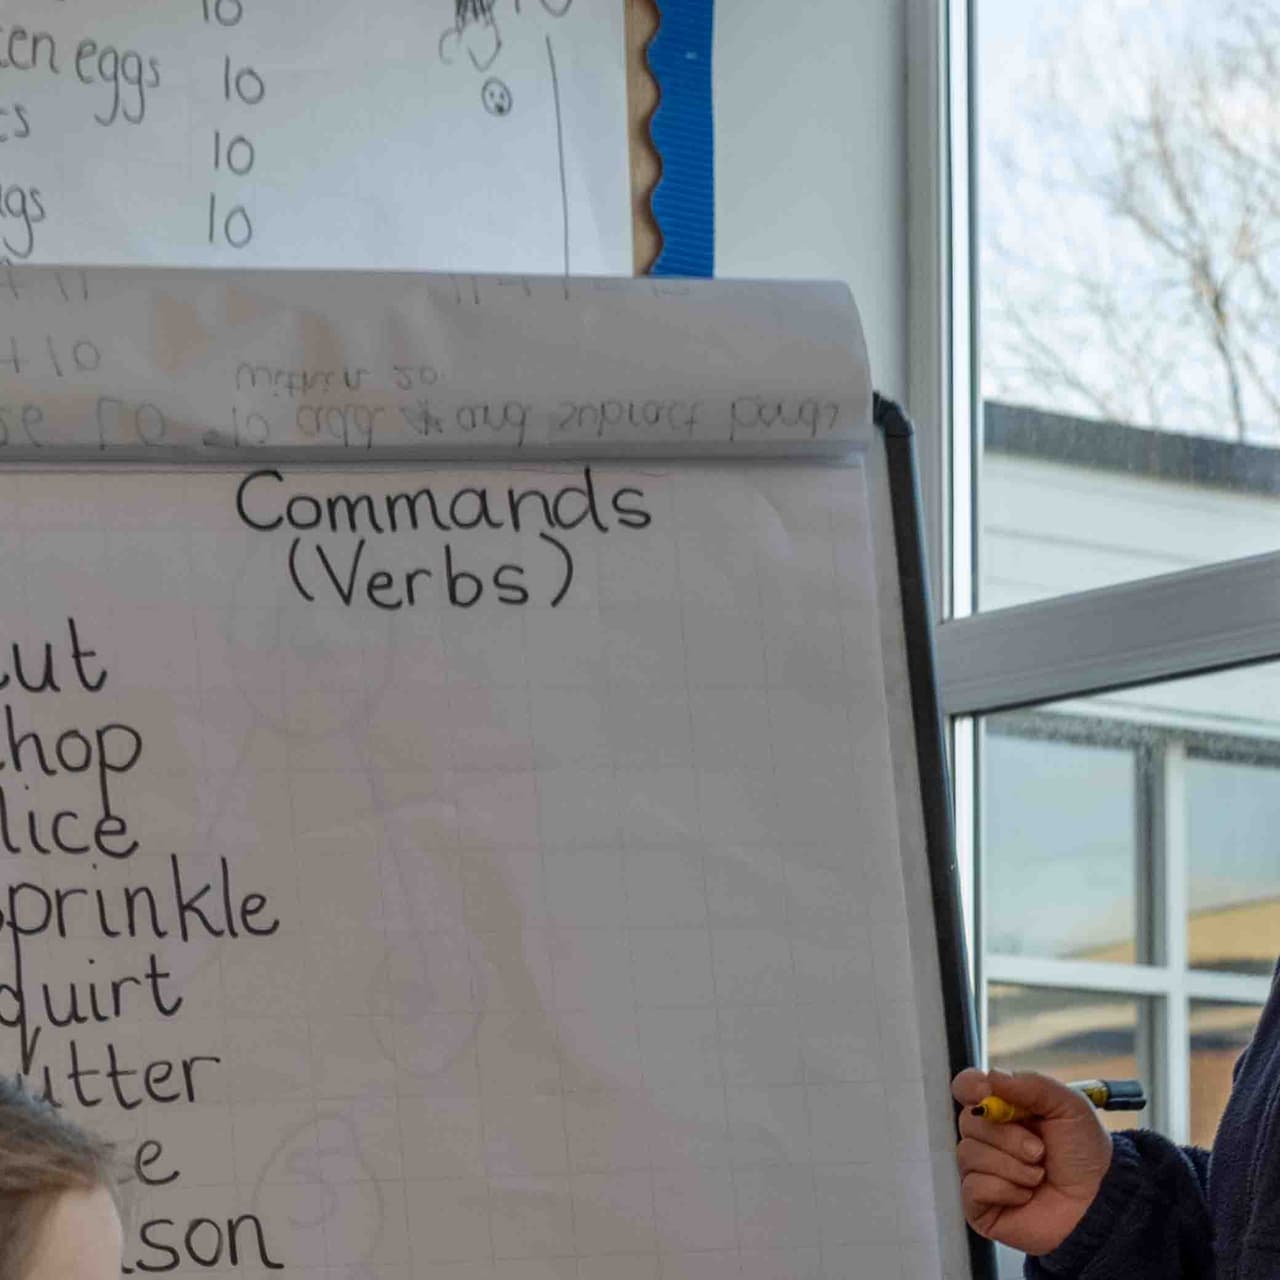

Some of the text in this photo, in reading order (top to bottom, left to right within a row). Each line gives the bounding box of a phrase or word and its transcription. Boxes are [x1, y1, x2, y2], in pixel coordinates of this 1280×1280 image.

[75, 37, 161, 126] eggs
[222, 55, 266, 105] 10
[213, 131, 256, 176] 10
[207, 191, 253, 249] 10
[236, 465, 653, 535] Commands
[288, 531, 574, 611] (Verbs)
[121, 1213, 285, 1275] son
